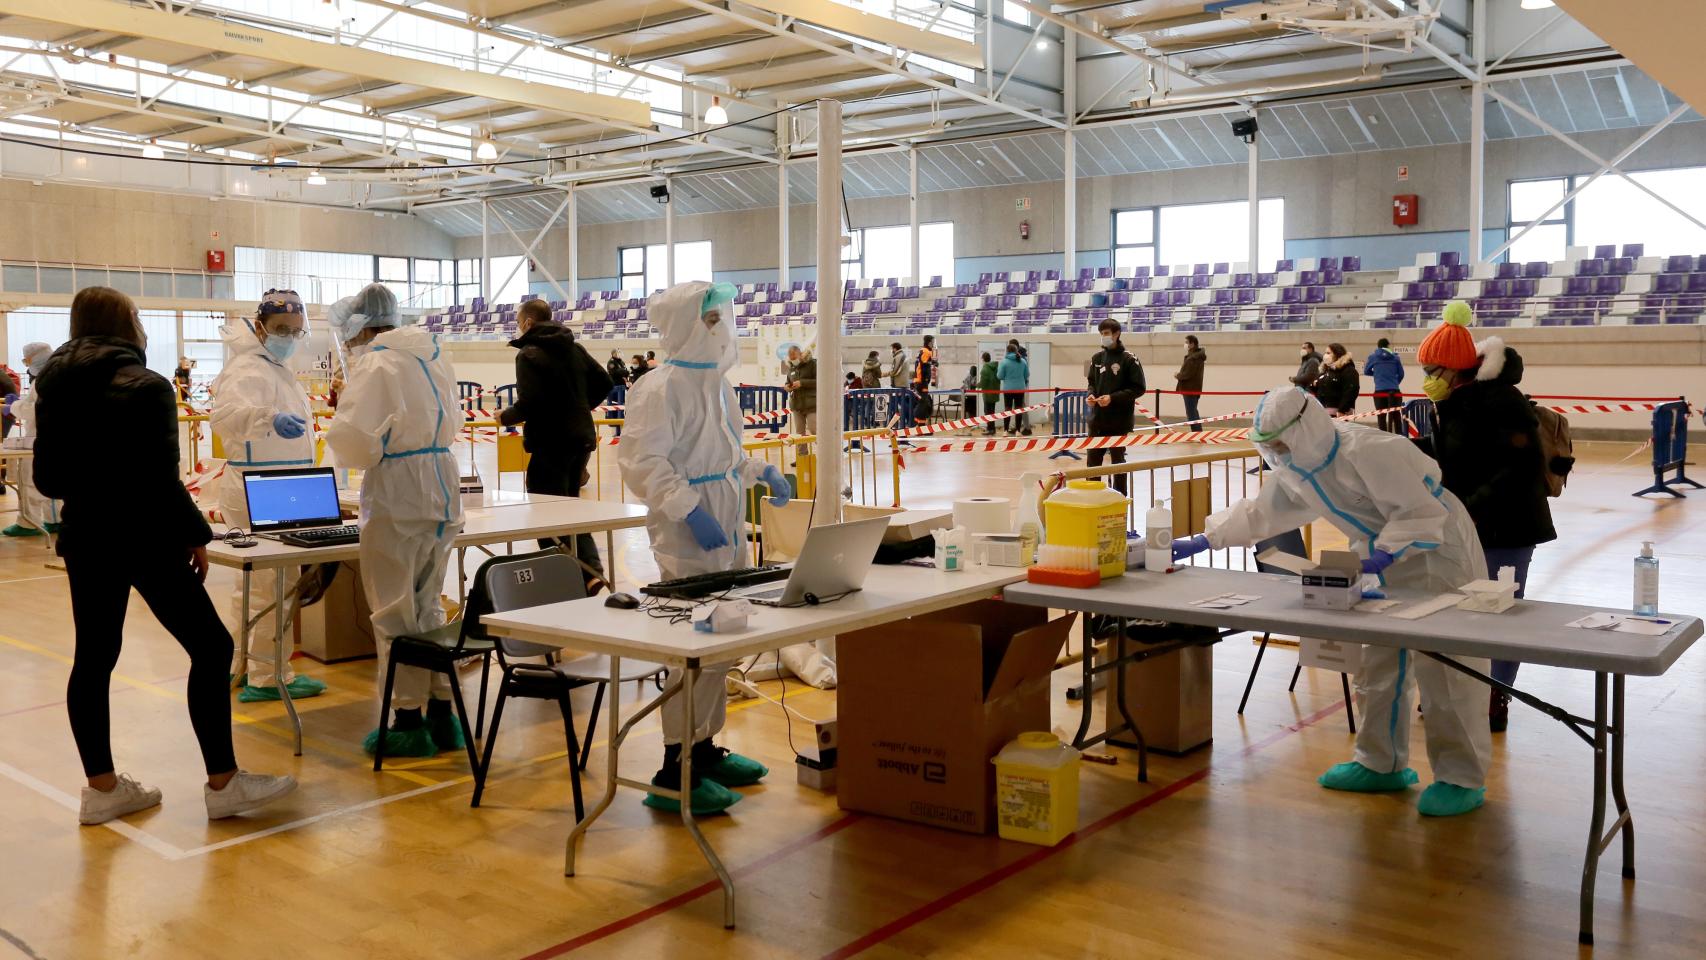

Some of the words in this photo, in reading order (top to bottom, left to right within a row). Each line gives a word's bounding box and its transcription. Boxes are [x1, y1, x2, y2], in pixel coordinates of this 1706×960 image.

[320, 361, 327, 370] 6
[514, 570, 532, 584] 183
[877, 758, 920, 775] Abbott
